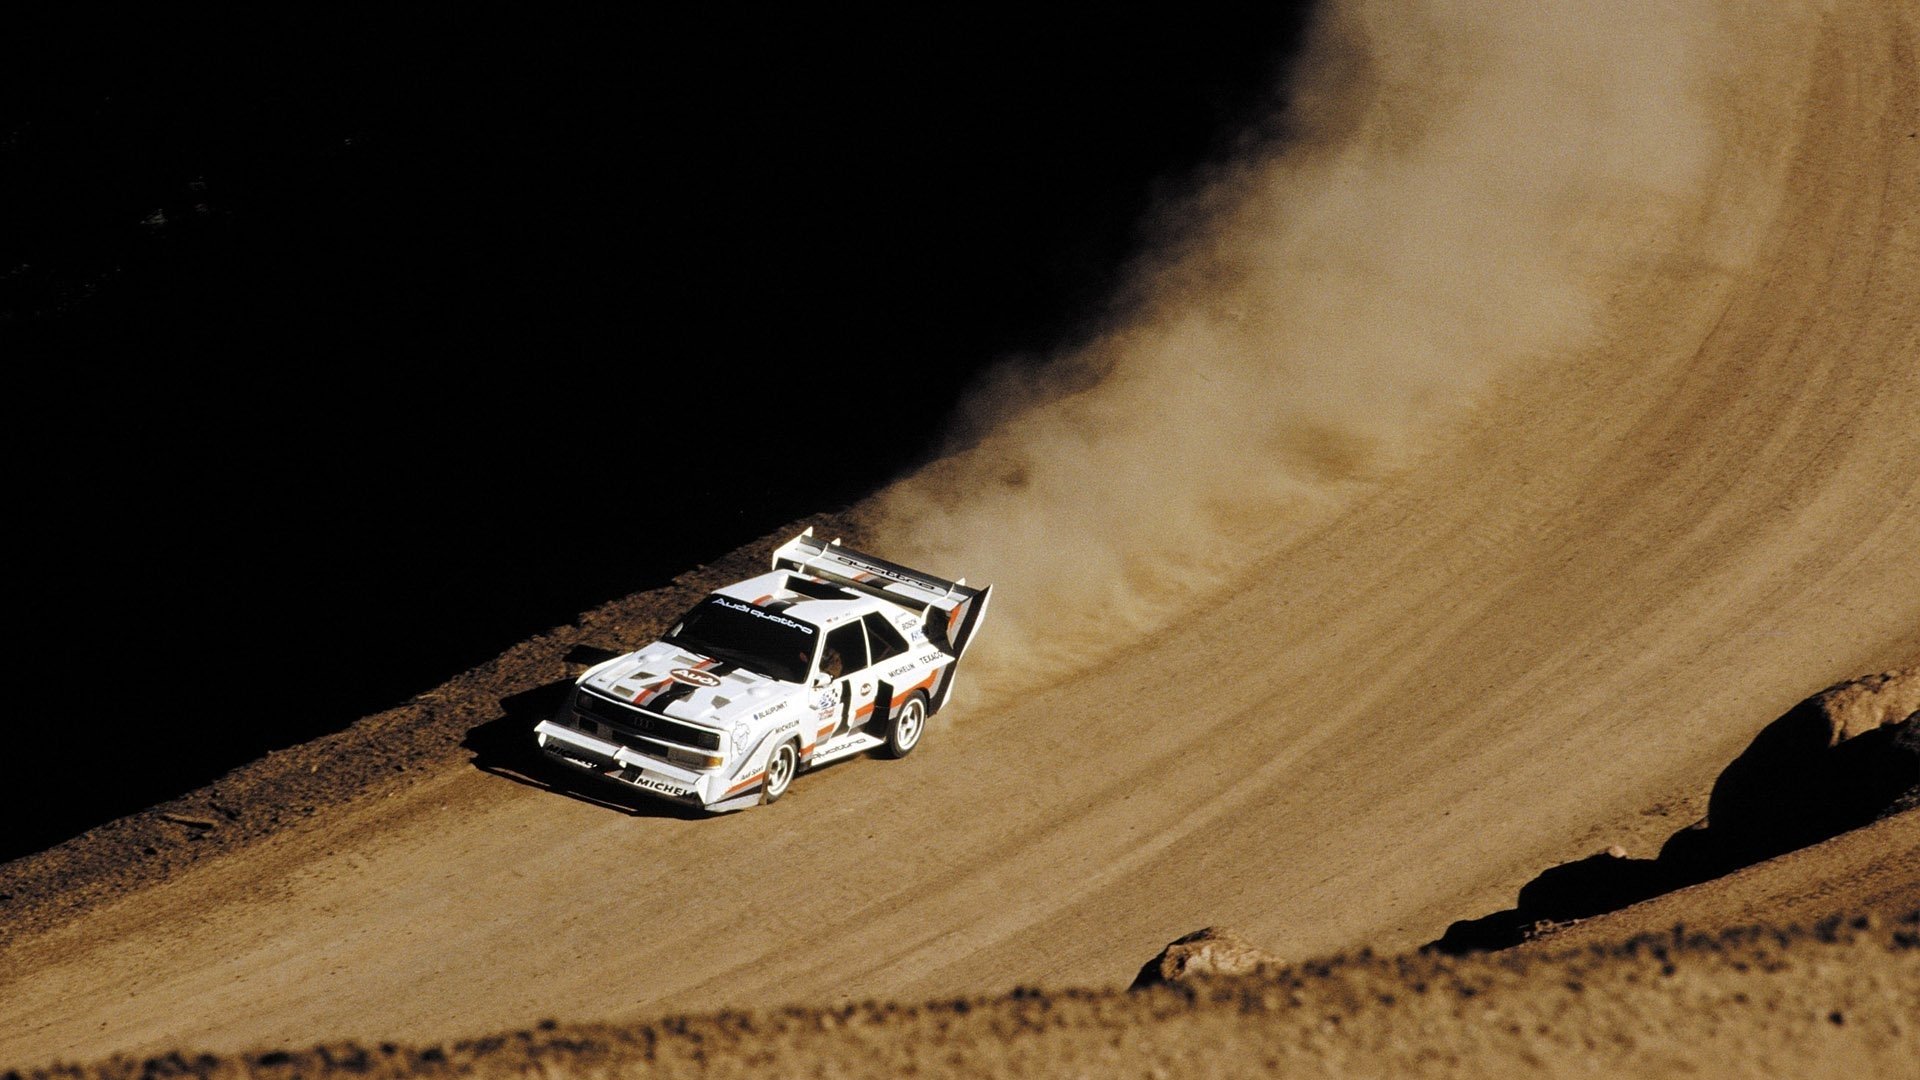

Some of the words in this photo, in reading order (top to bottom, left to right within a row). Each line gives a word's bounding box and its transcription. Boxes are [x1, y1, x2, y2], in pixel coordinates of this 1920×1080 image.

[838, 557, 935, 590] quattro
[712, 598, 749, 614] Audi
[750, 609, 813, 634] quattro
[919, 651, 944, 665] TEXACO
[888, 663, 916, 679] MICHELIN
[758, 700, 788, 719] BLAUPUNKT
[775, 719, 800, 734] MICHELIN
[812, 738, 867, 759] quattro
